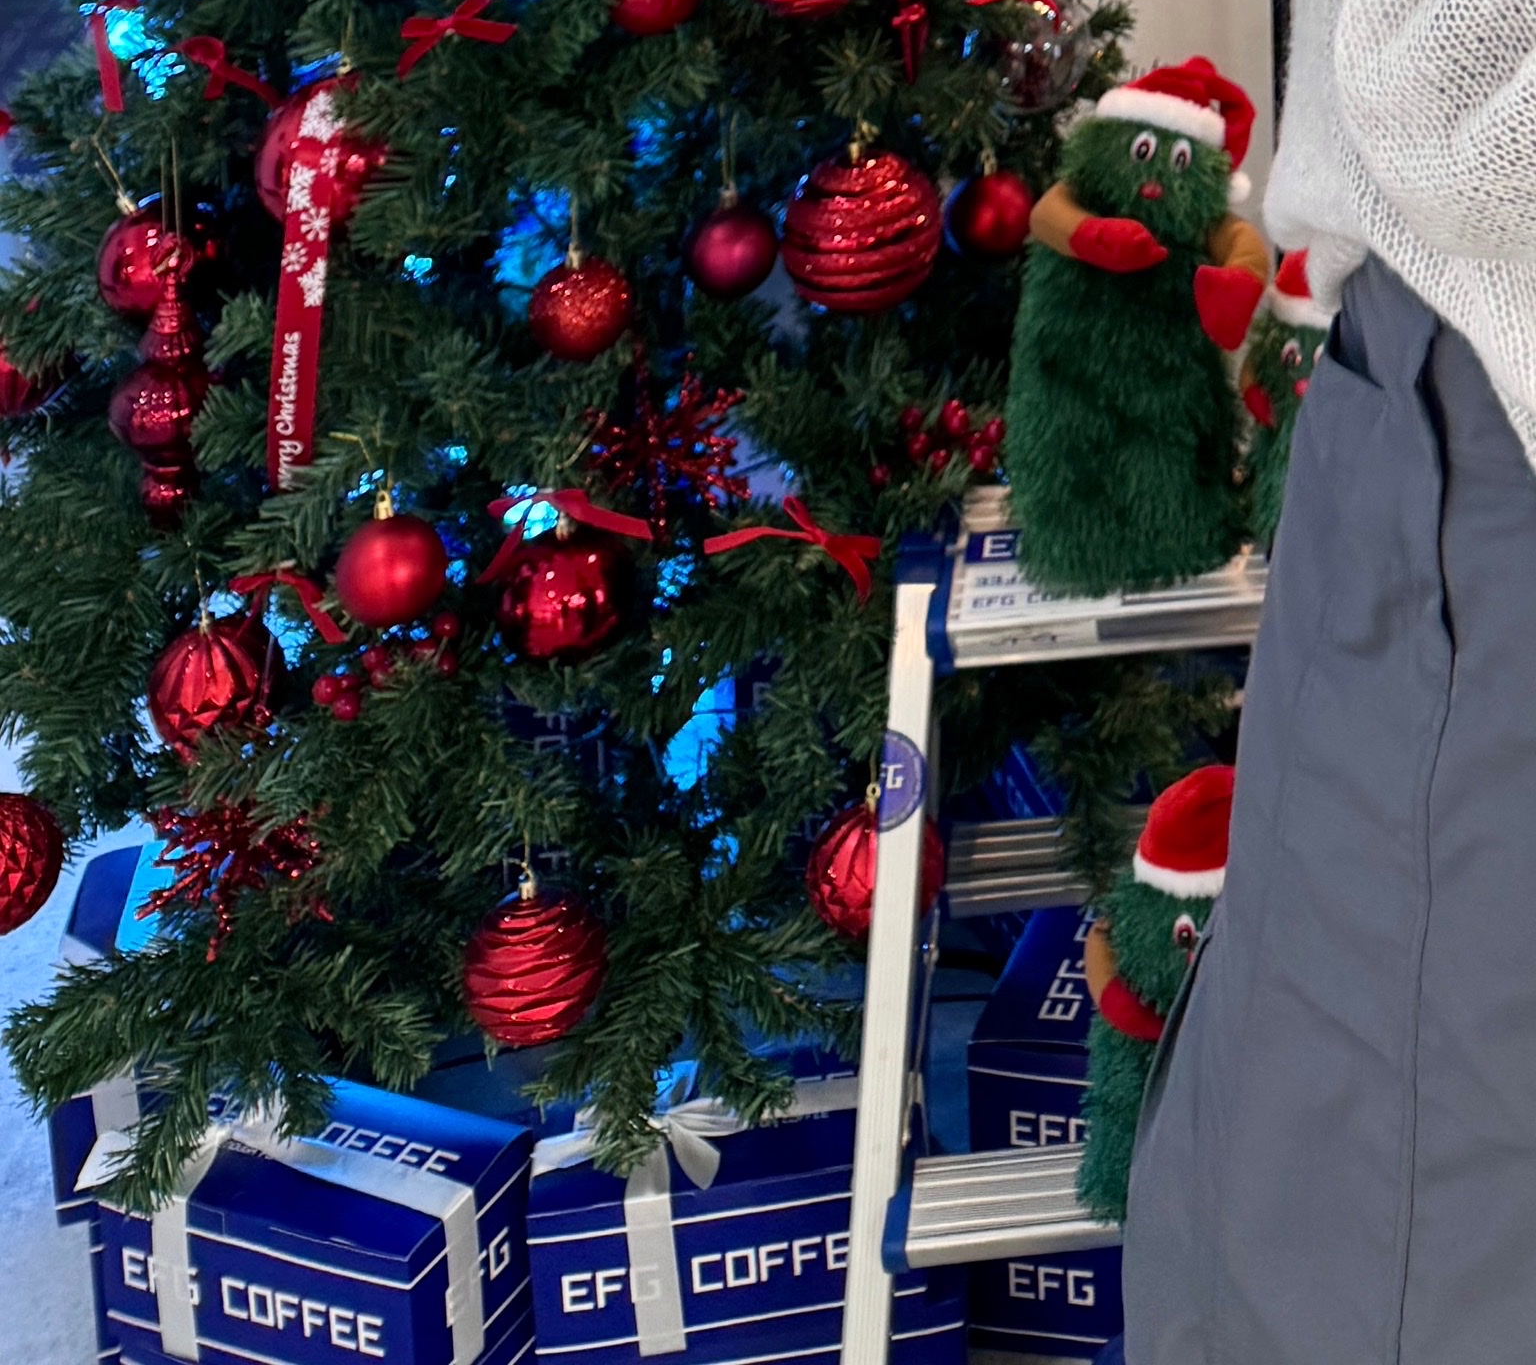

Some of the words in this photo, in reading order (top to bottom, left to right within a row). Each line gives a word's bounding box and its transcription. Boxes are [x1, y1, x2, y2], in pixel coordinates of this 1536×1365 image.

[274, 330, 302, 437] Christmas
[971, 594, 1016, 610] EFG
[220, 1275, 386, 1358] COFFEE
[1008, 1262, 1095, 1307] EFG
